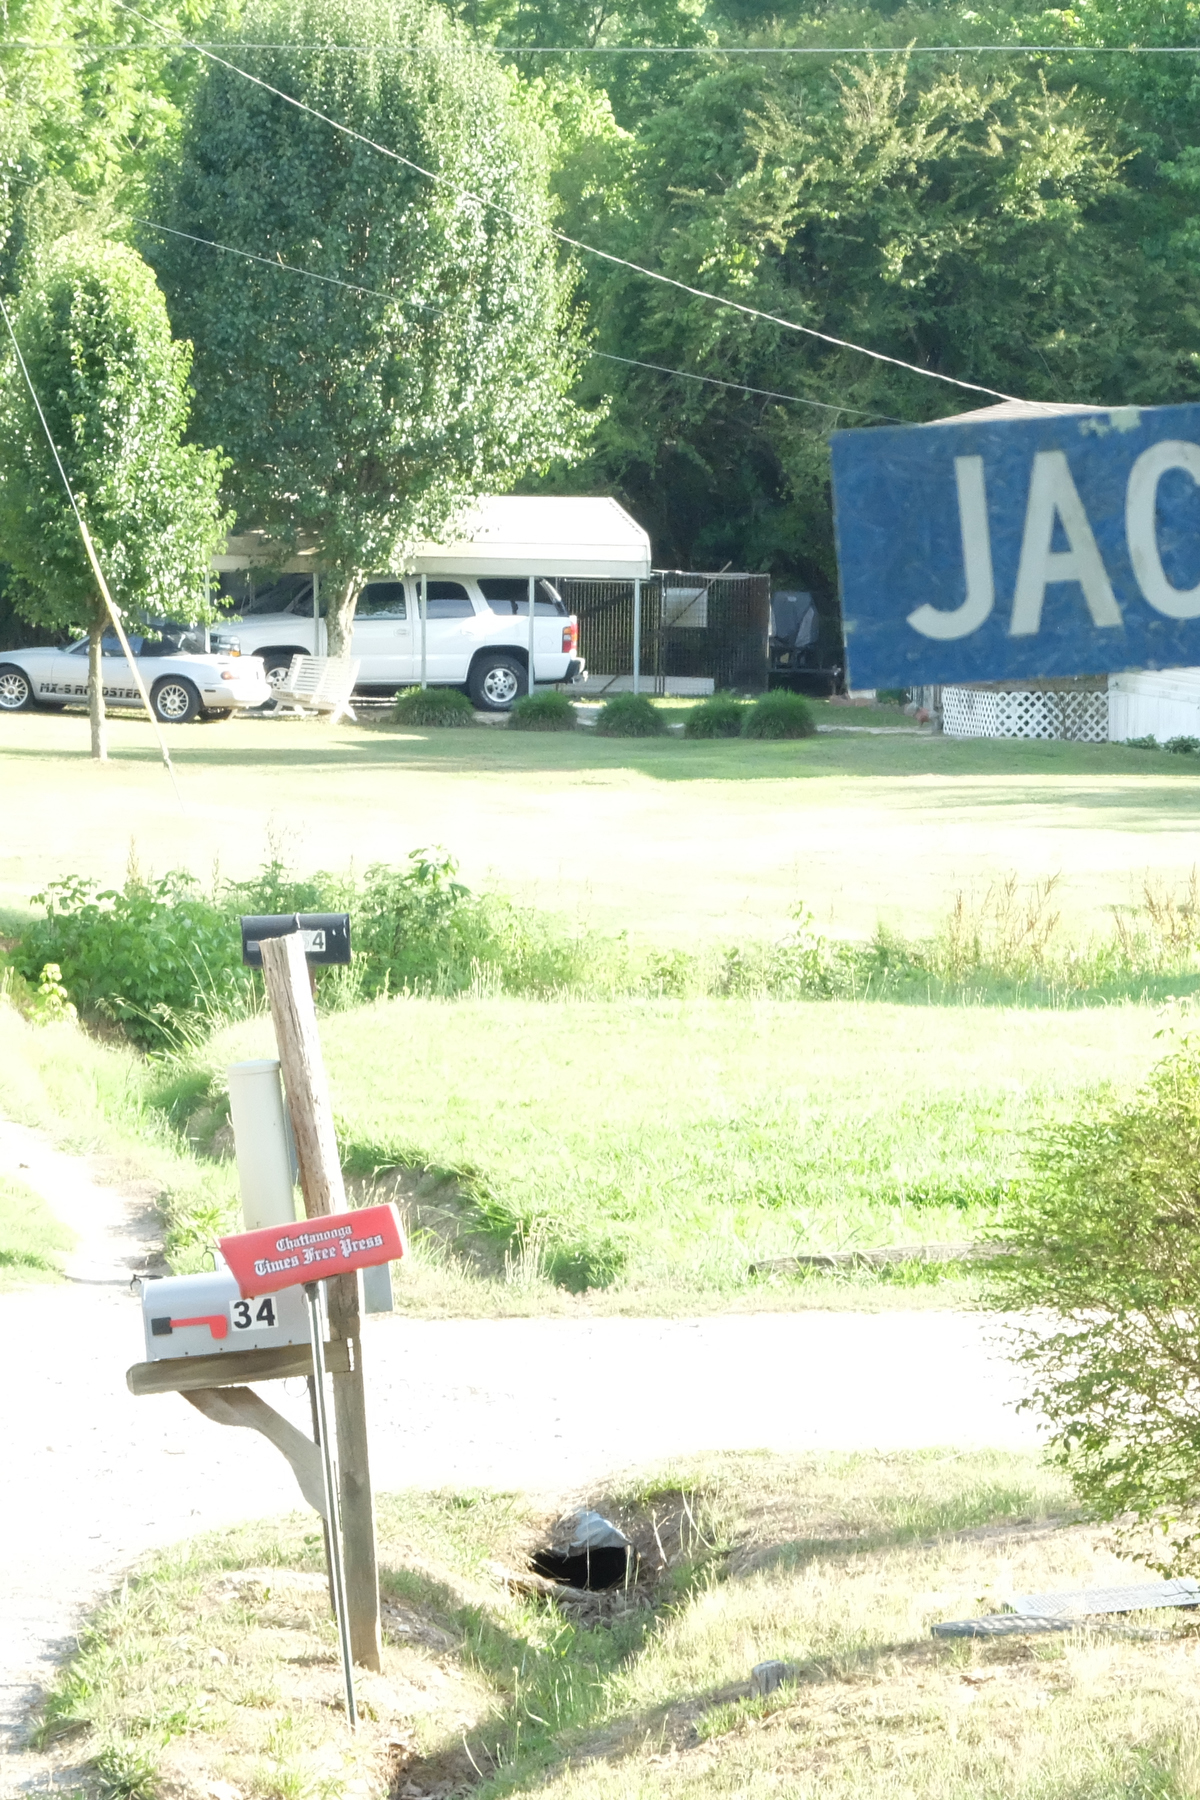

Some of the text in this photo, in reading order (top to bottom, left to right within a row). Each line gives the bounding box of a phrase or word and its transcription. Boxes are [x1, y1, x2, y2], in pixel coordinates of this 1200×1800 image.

[40, 683, 142, 699] MX-5 RDSTER
[275, 1225, 353, 1252] Chattanooga
[253, 1234, 384, 1276] Times Free Press
[233, 1298, 275, 1329] 34
